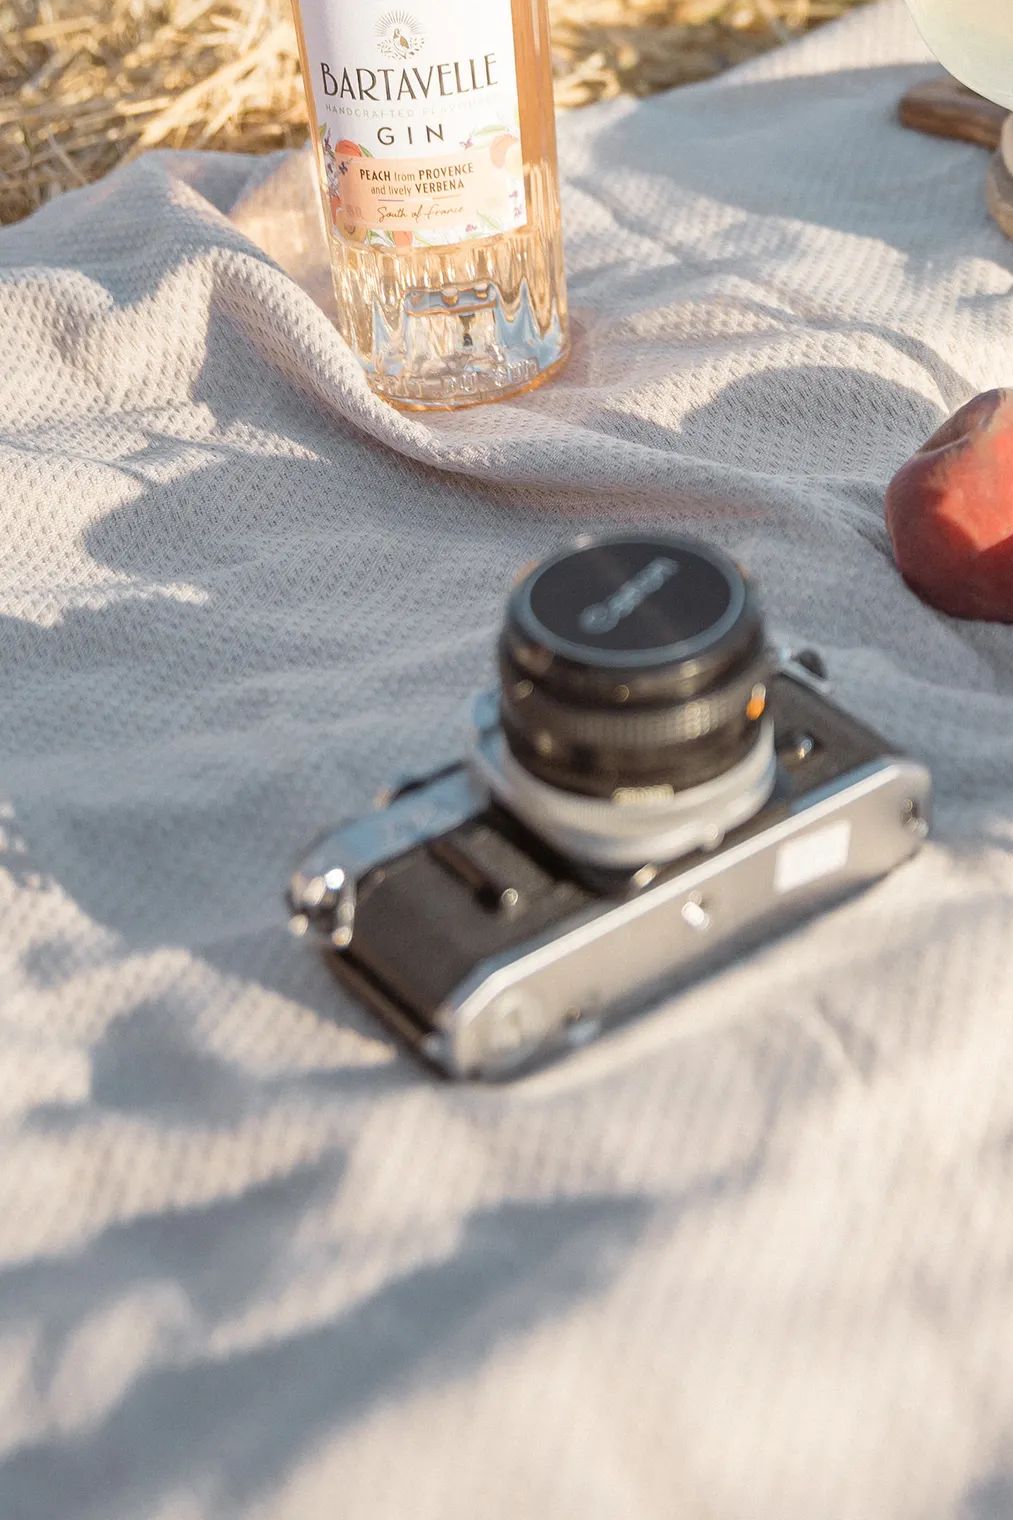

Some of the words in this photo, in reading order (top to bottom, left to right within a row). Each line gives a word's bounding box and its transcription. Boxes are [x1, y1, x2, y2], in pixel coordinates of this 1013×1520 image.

[321, 53, 499, 101] BARTAVELLE
[325, 104, 414, 119] HANDCRAFTED
[377, 123, 444, 146] GIN
[359, 168, 391, 181] PEACH
[394, 171, 415, 182] from
[419, 162, 474, 181] PROVENCE
[371, 184, 386, 195] and
[388, 184, 412, 197] lively
[415, 178, 465, 194] VERBENA
[377, 206, 407, 223] South
[412, 204, 423, 223] of
